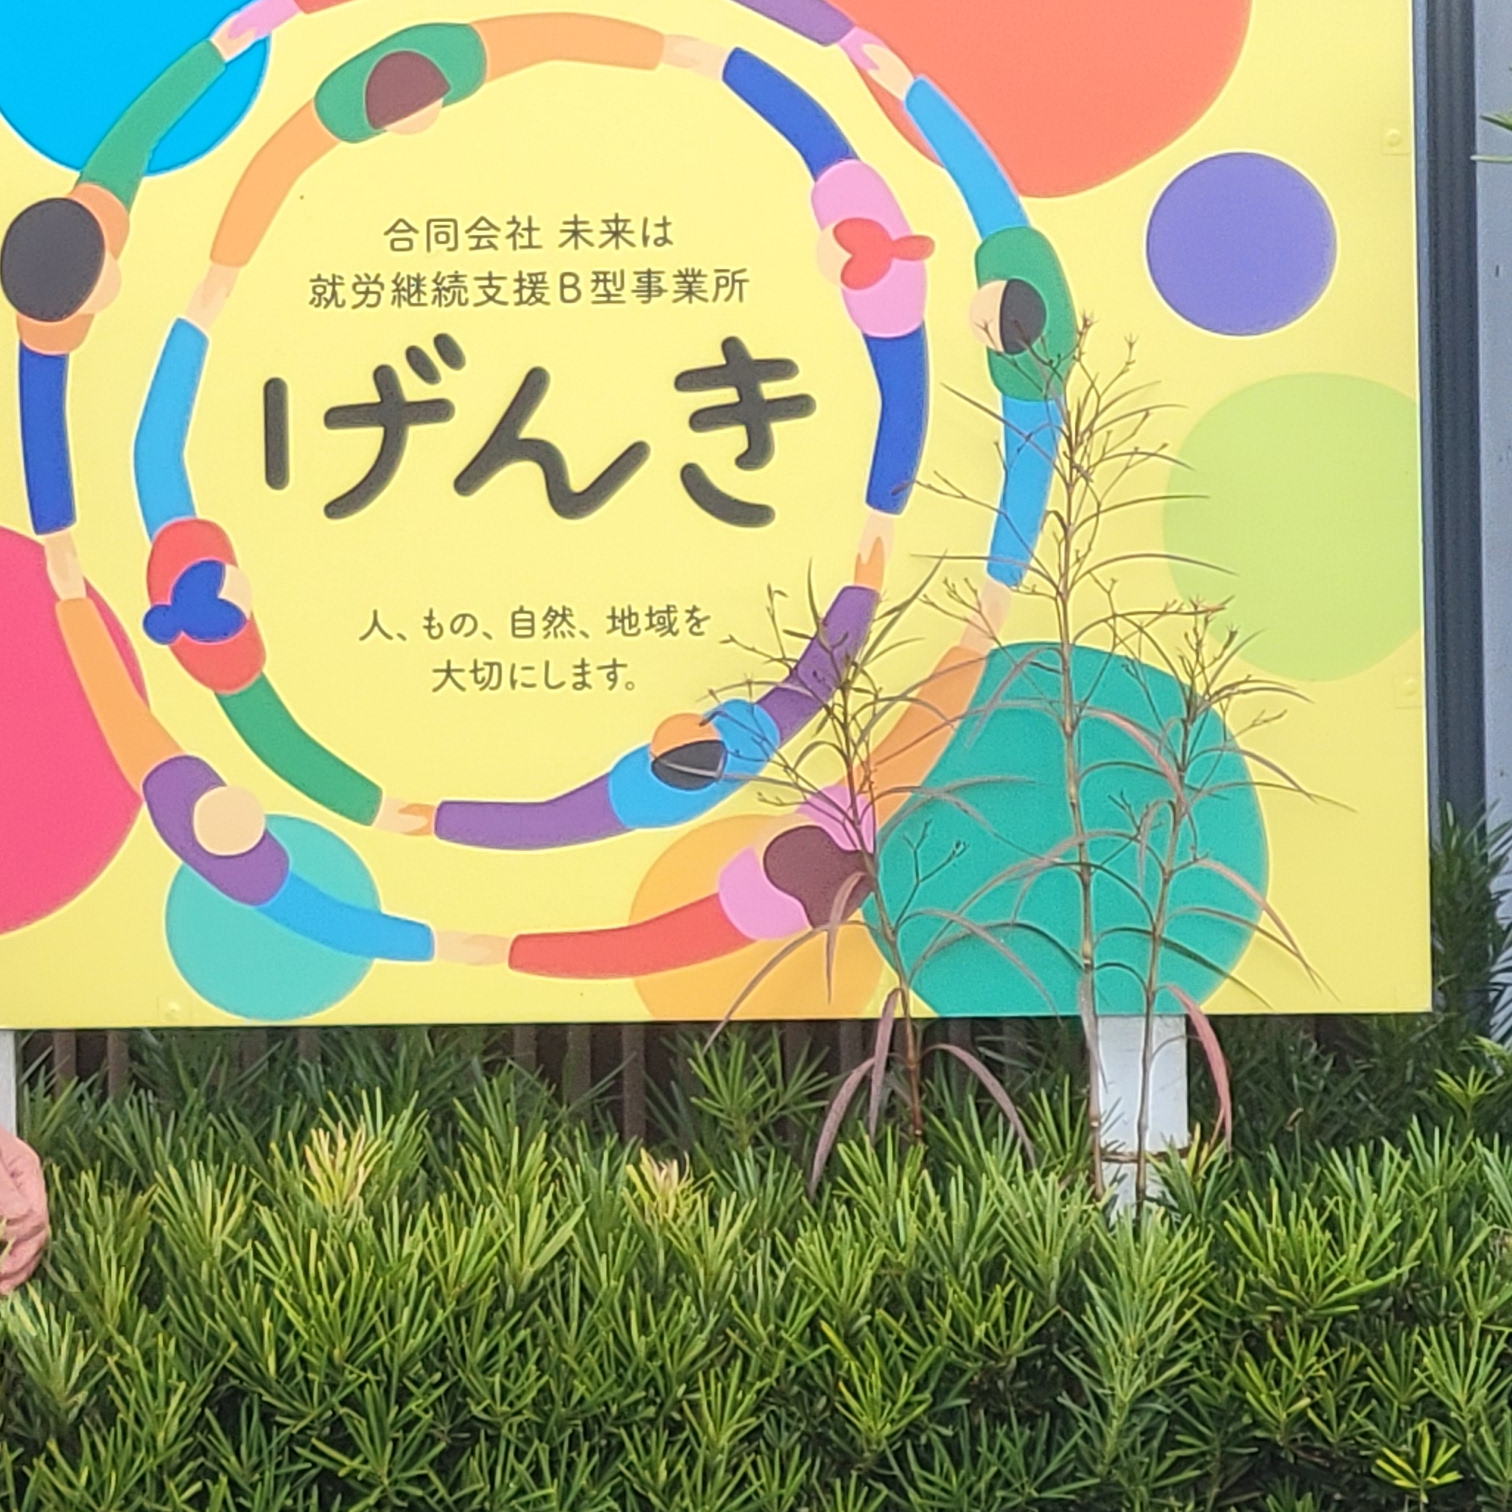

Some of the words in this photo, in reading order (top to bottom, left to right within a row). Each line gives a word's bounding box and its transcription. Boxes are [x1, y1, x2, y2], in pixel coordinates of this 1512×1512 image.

[383, 215, 543, 253] 合同会社
[558, 212, 674, 250] 未来は
[308, 267, 750, 310] 就労継続支援B型事業所
[263, 333, 816, 528] げんき
[358, 604, 712, 642] 人、もの、自然、地域を
[431, 657, 636, 693] 大切にします。
